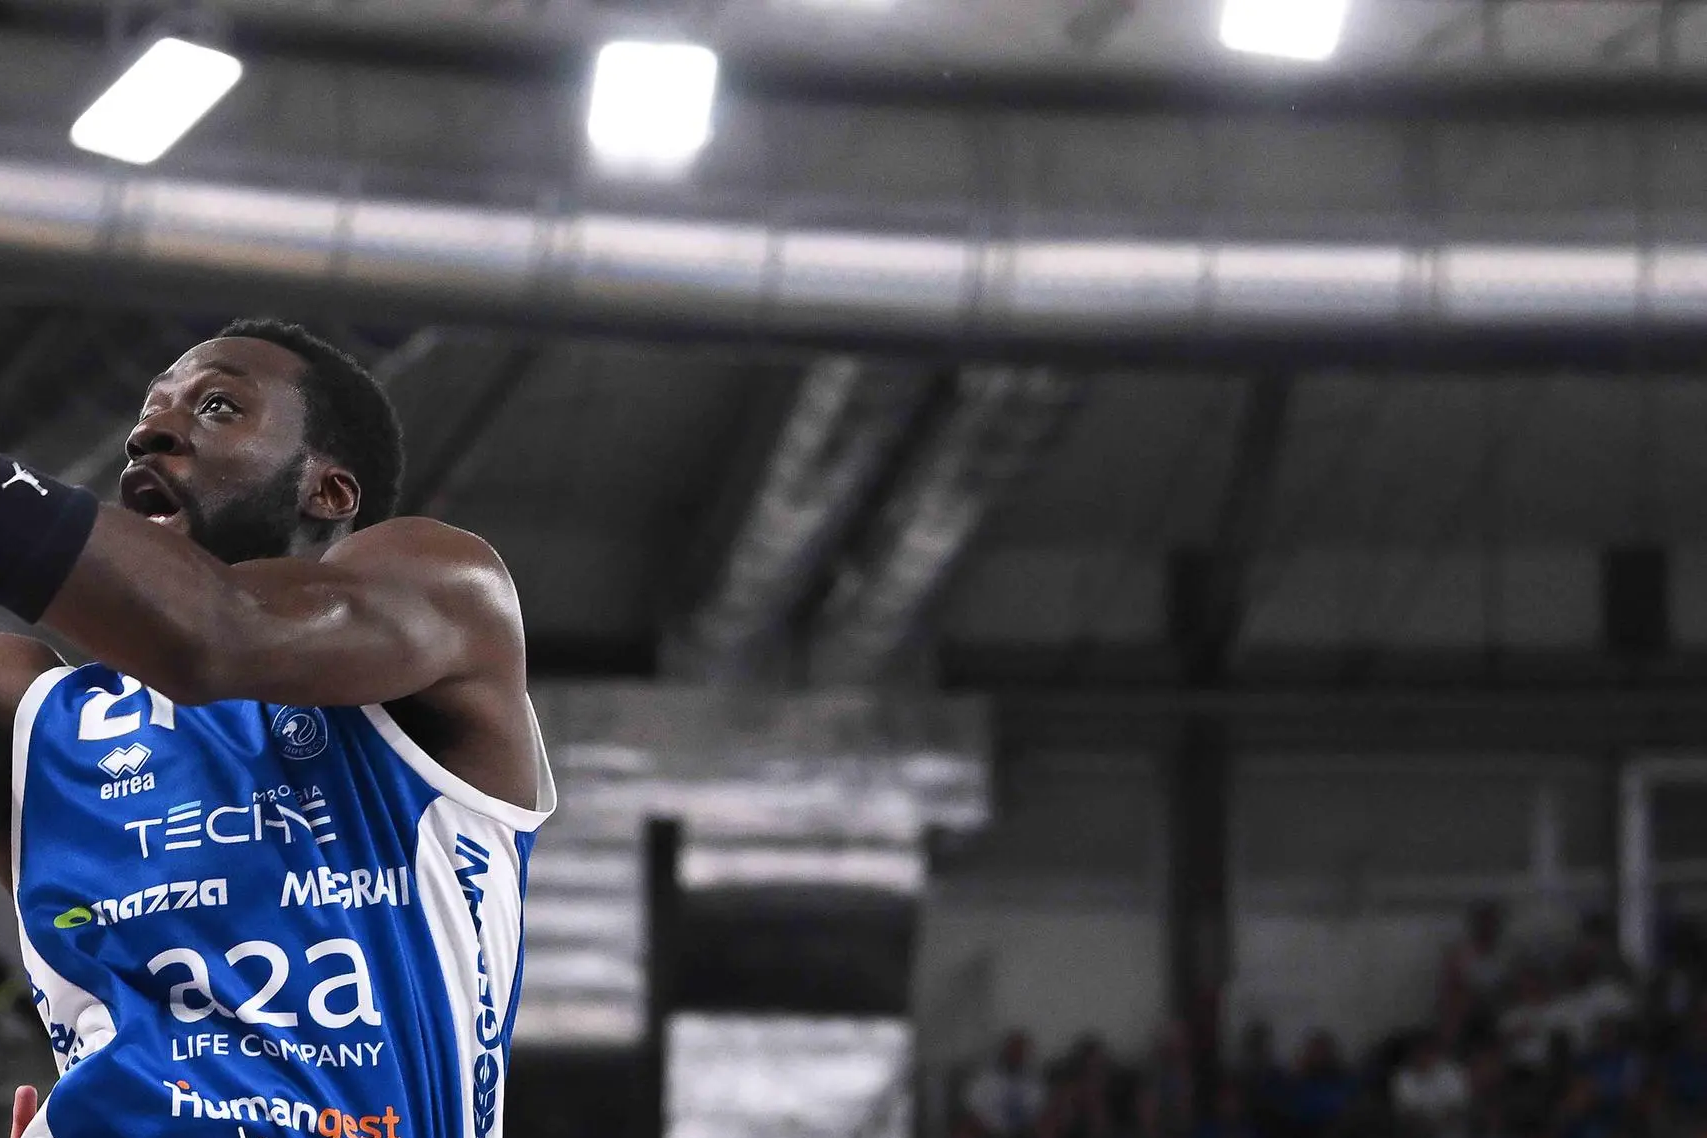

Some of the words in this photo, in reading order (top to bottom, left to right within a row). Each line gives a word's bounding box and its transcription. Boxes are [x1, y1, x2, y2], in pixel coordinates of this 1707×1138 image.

[100, 771, 155, 800] errea
[147, 937, 382, 1028] a2a
[172, 1033, 229, 1062] LIFE
[240, 1033, 385, 1067] COMPANY
